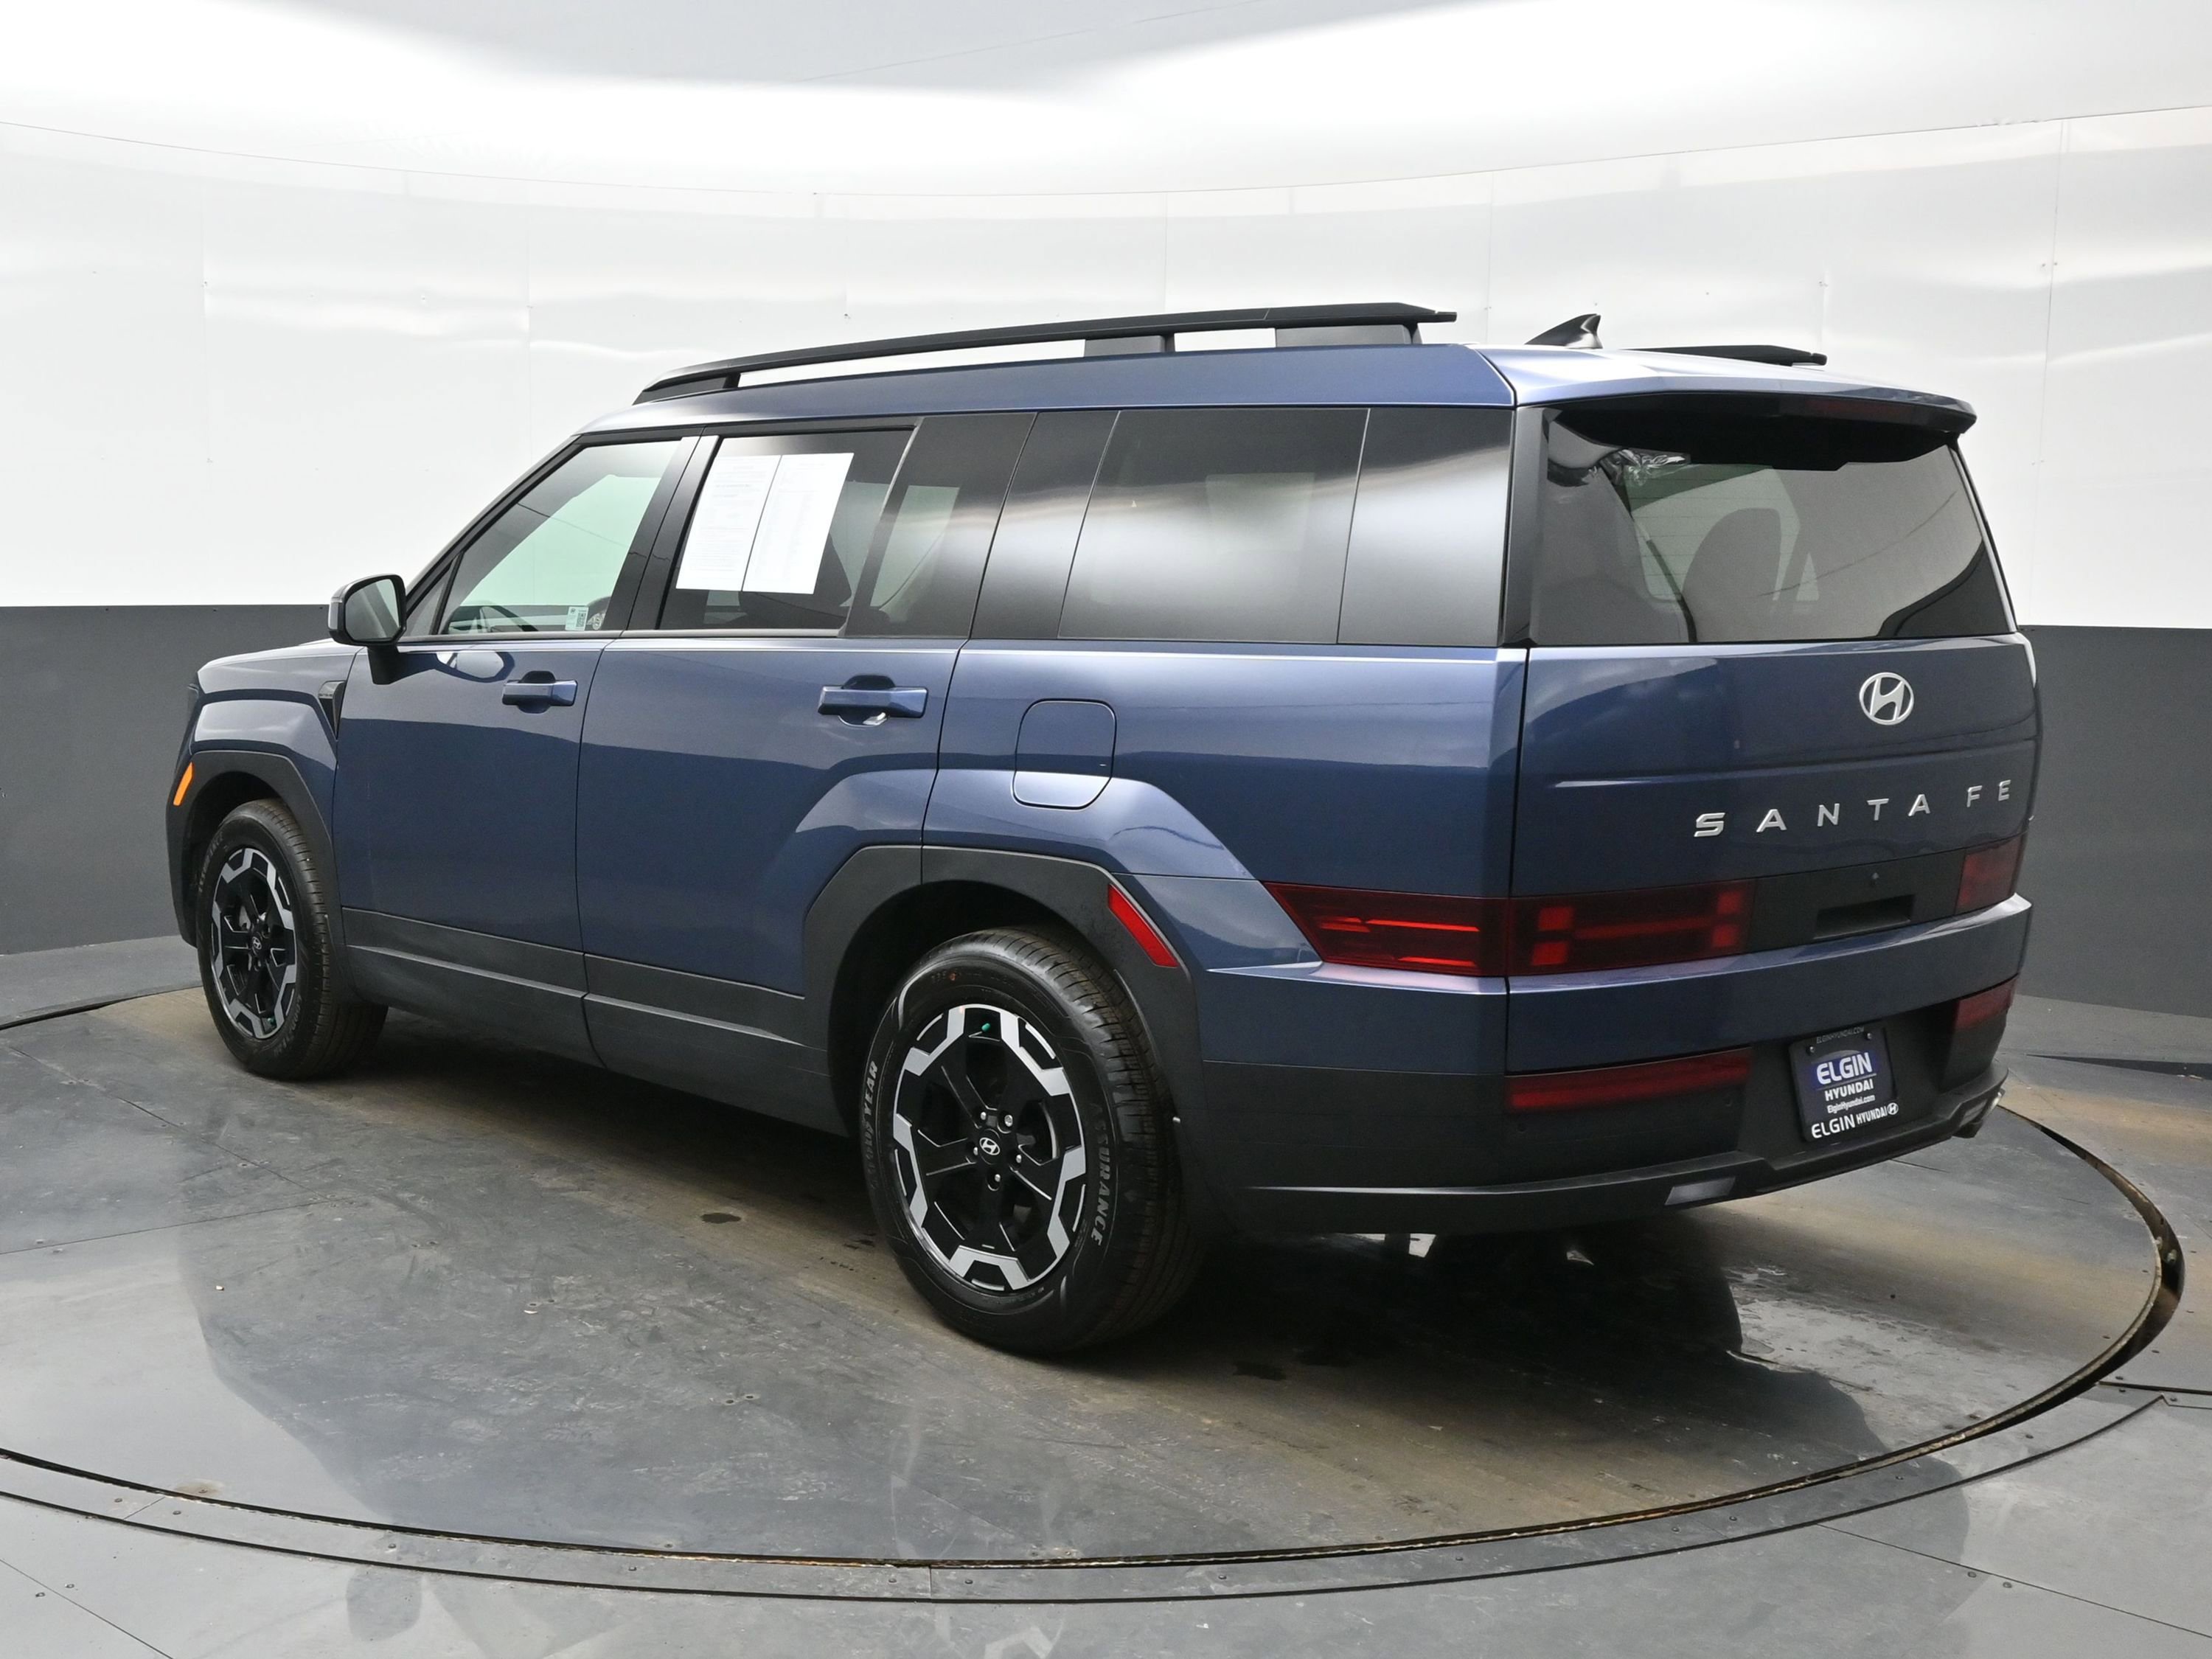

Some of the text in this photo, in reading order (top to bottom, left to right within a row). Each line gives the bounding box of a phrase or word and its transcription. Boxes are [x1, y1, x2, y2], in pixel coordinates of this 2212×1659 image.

[1694, 779, 2012, 838] SANTA FE
[1816, 1052, 1873, 1085] ELGIN
[1824, 1079, 1874, 1102] HYUNDAI
[1811, 1106, 1888, 1138] ELGIN HYUNDAI
